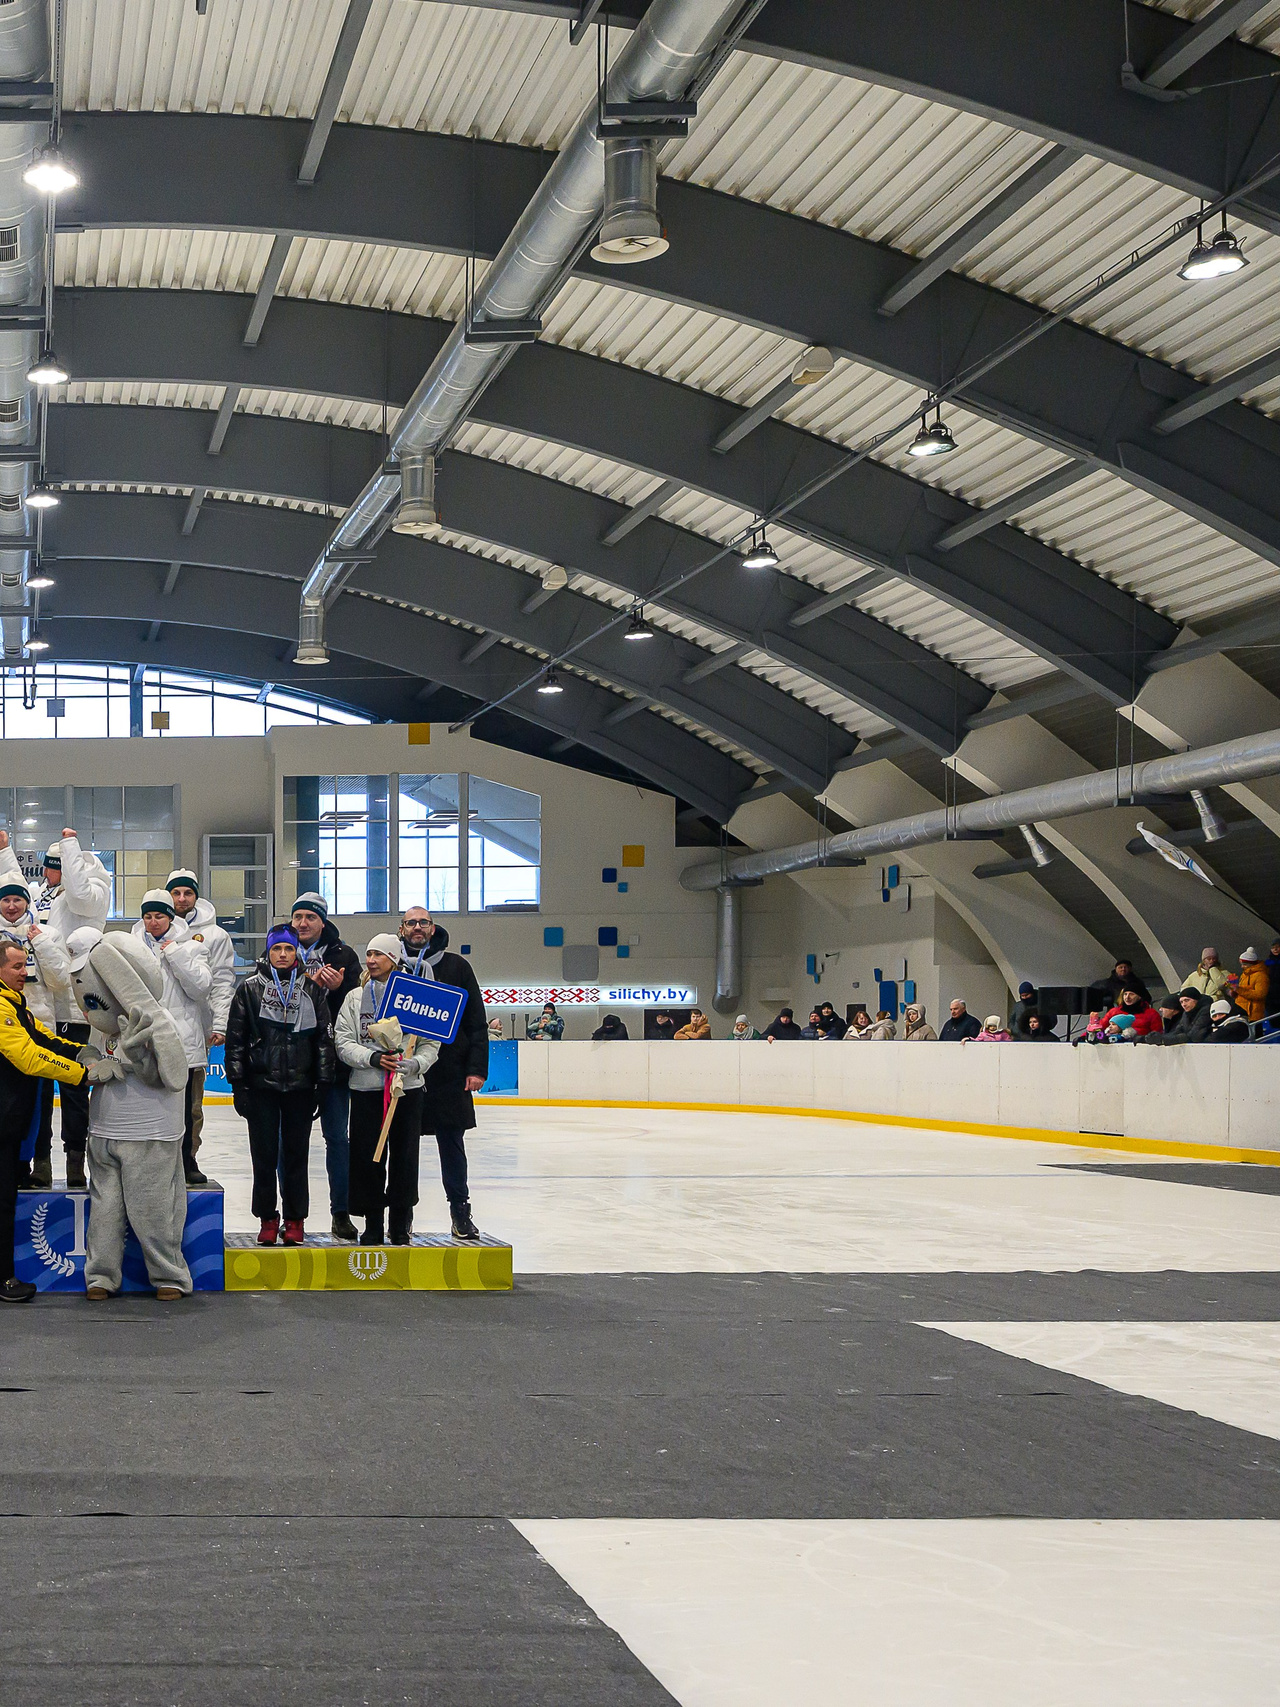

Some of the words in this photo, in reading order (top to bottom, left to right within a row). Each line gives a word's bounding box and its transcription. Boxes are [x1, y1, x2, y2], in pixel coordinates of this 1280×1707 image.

[608, 988, 689, 1002] silichy.by
[393, 993, 450, 1022] Единые
[37, 1052, 71, 1071] BELARUS
